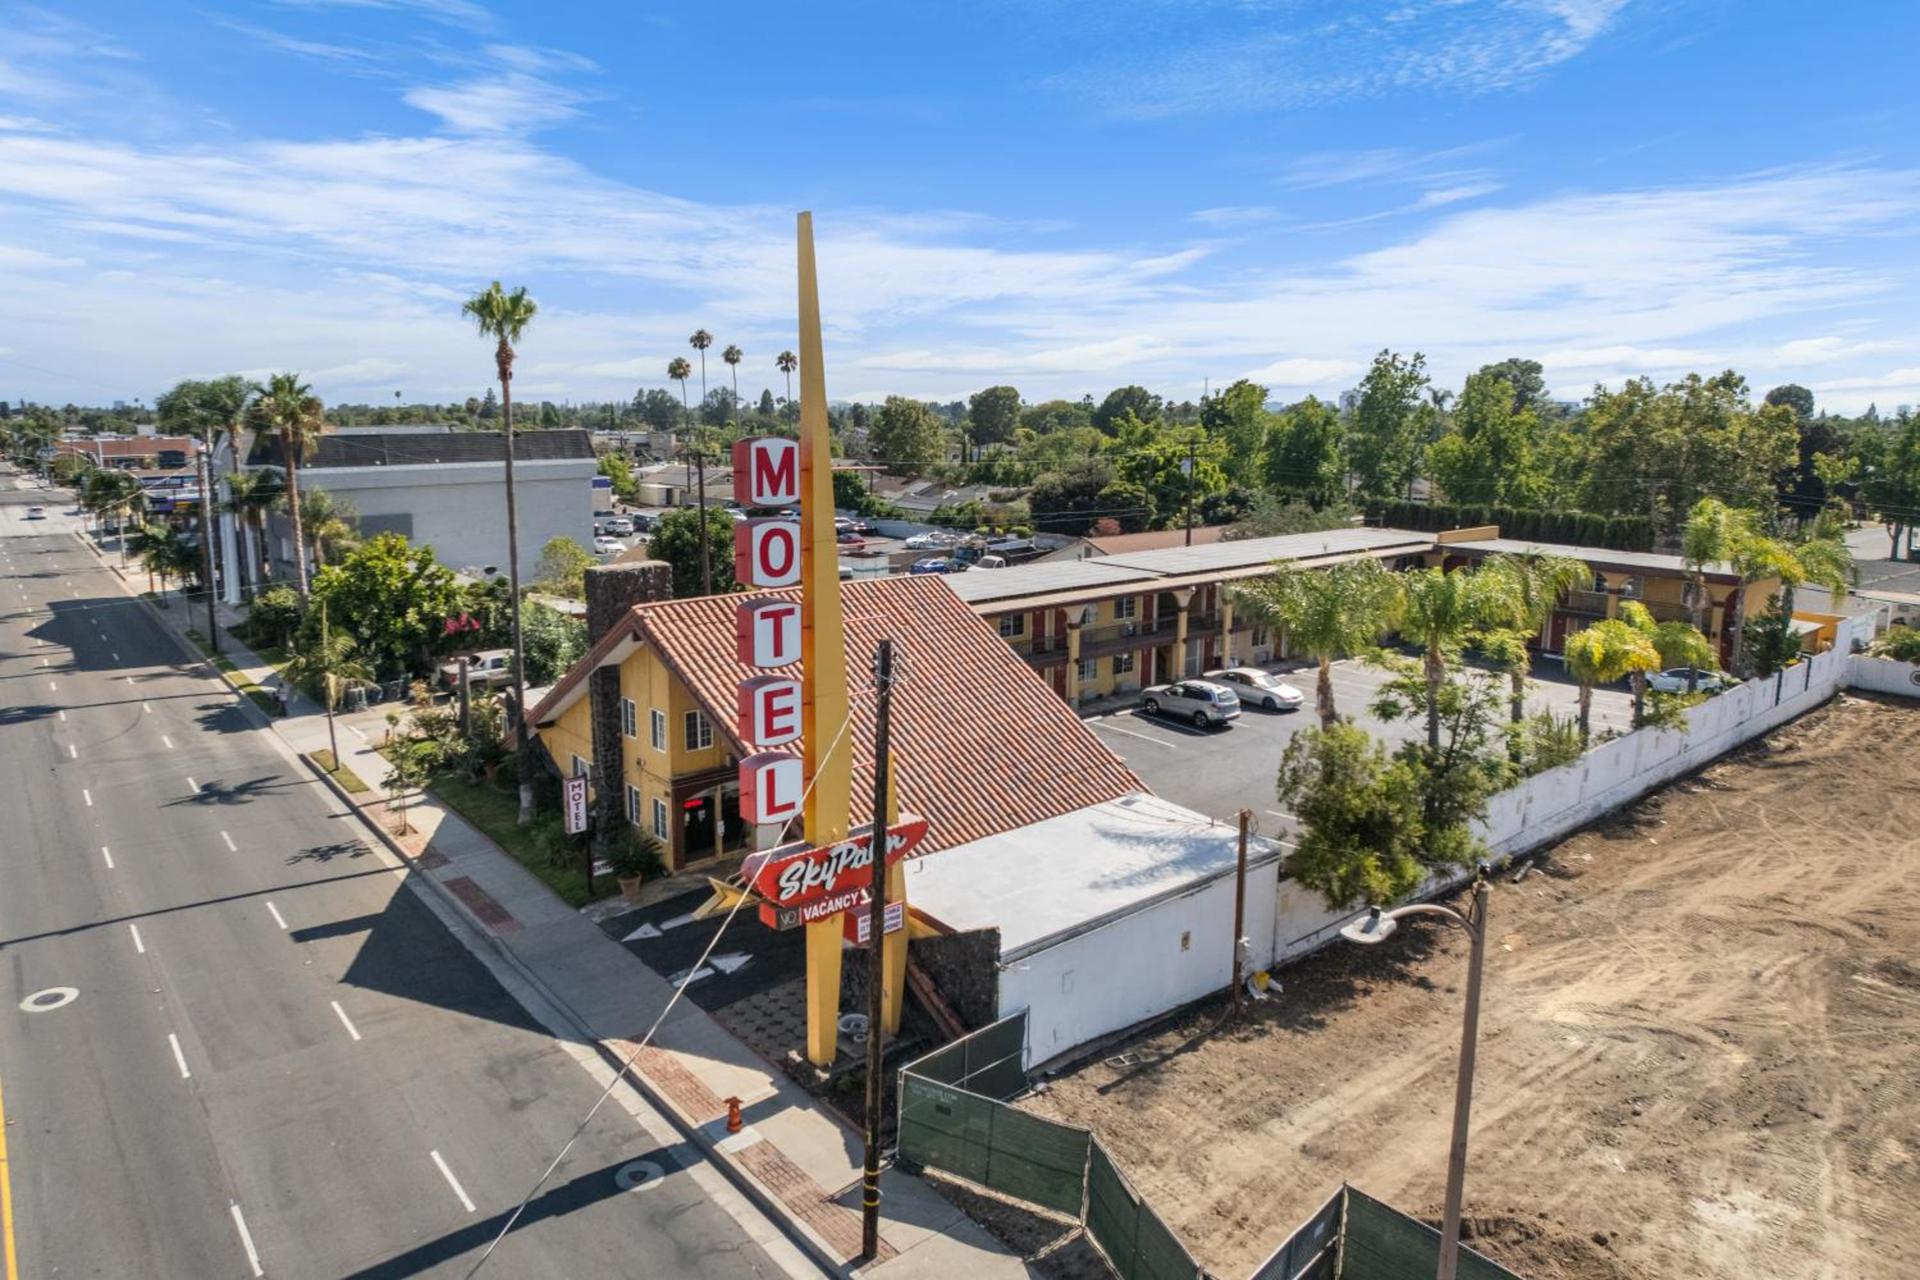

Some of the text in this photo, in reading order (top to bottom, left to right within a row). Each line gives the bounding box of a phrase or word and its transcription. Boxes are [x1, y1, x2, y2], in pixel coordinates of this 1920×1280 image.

[755, 446, 797, 817] MOTEL
[571, 782, 582, 830] MOTEL
[803, 892, 859, 920] VACANCY
